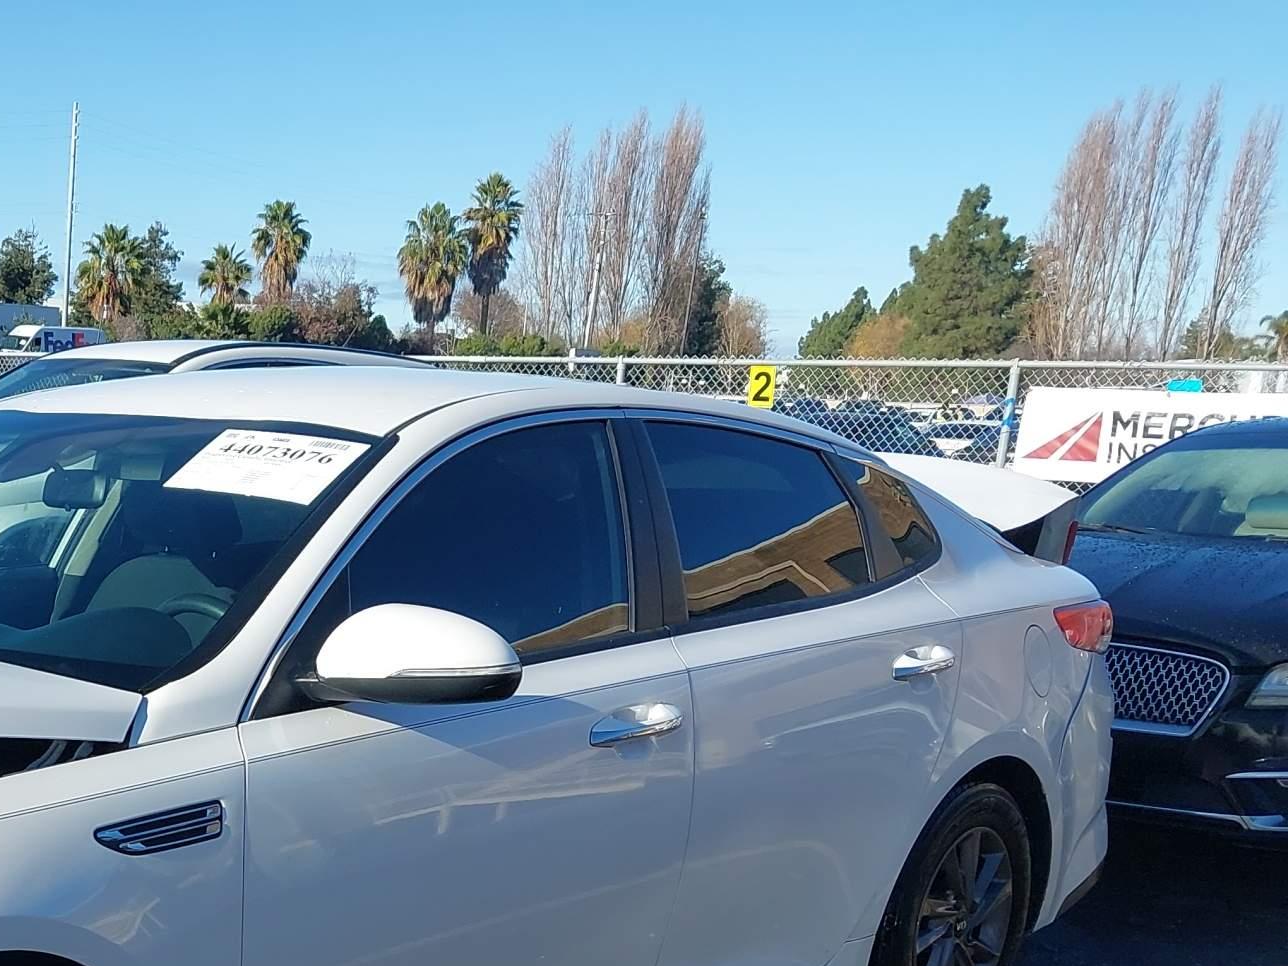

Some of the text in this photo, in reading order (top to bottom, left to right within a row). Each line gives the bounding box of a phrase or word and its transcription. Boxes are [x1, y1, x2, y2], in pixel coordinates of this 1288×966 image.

[43, 331, 96, 353] FedE
[752, 371, 772, 402] 2
[1110, 411, 1282, 440] MER
[219, 442, 337, 465] 44073076
